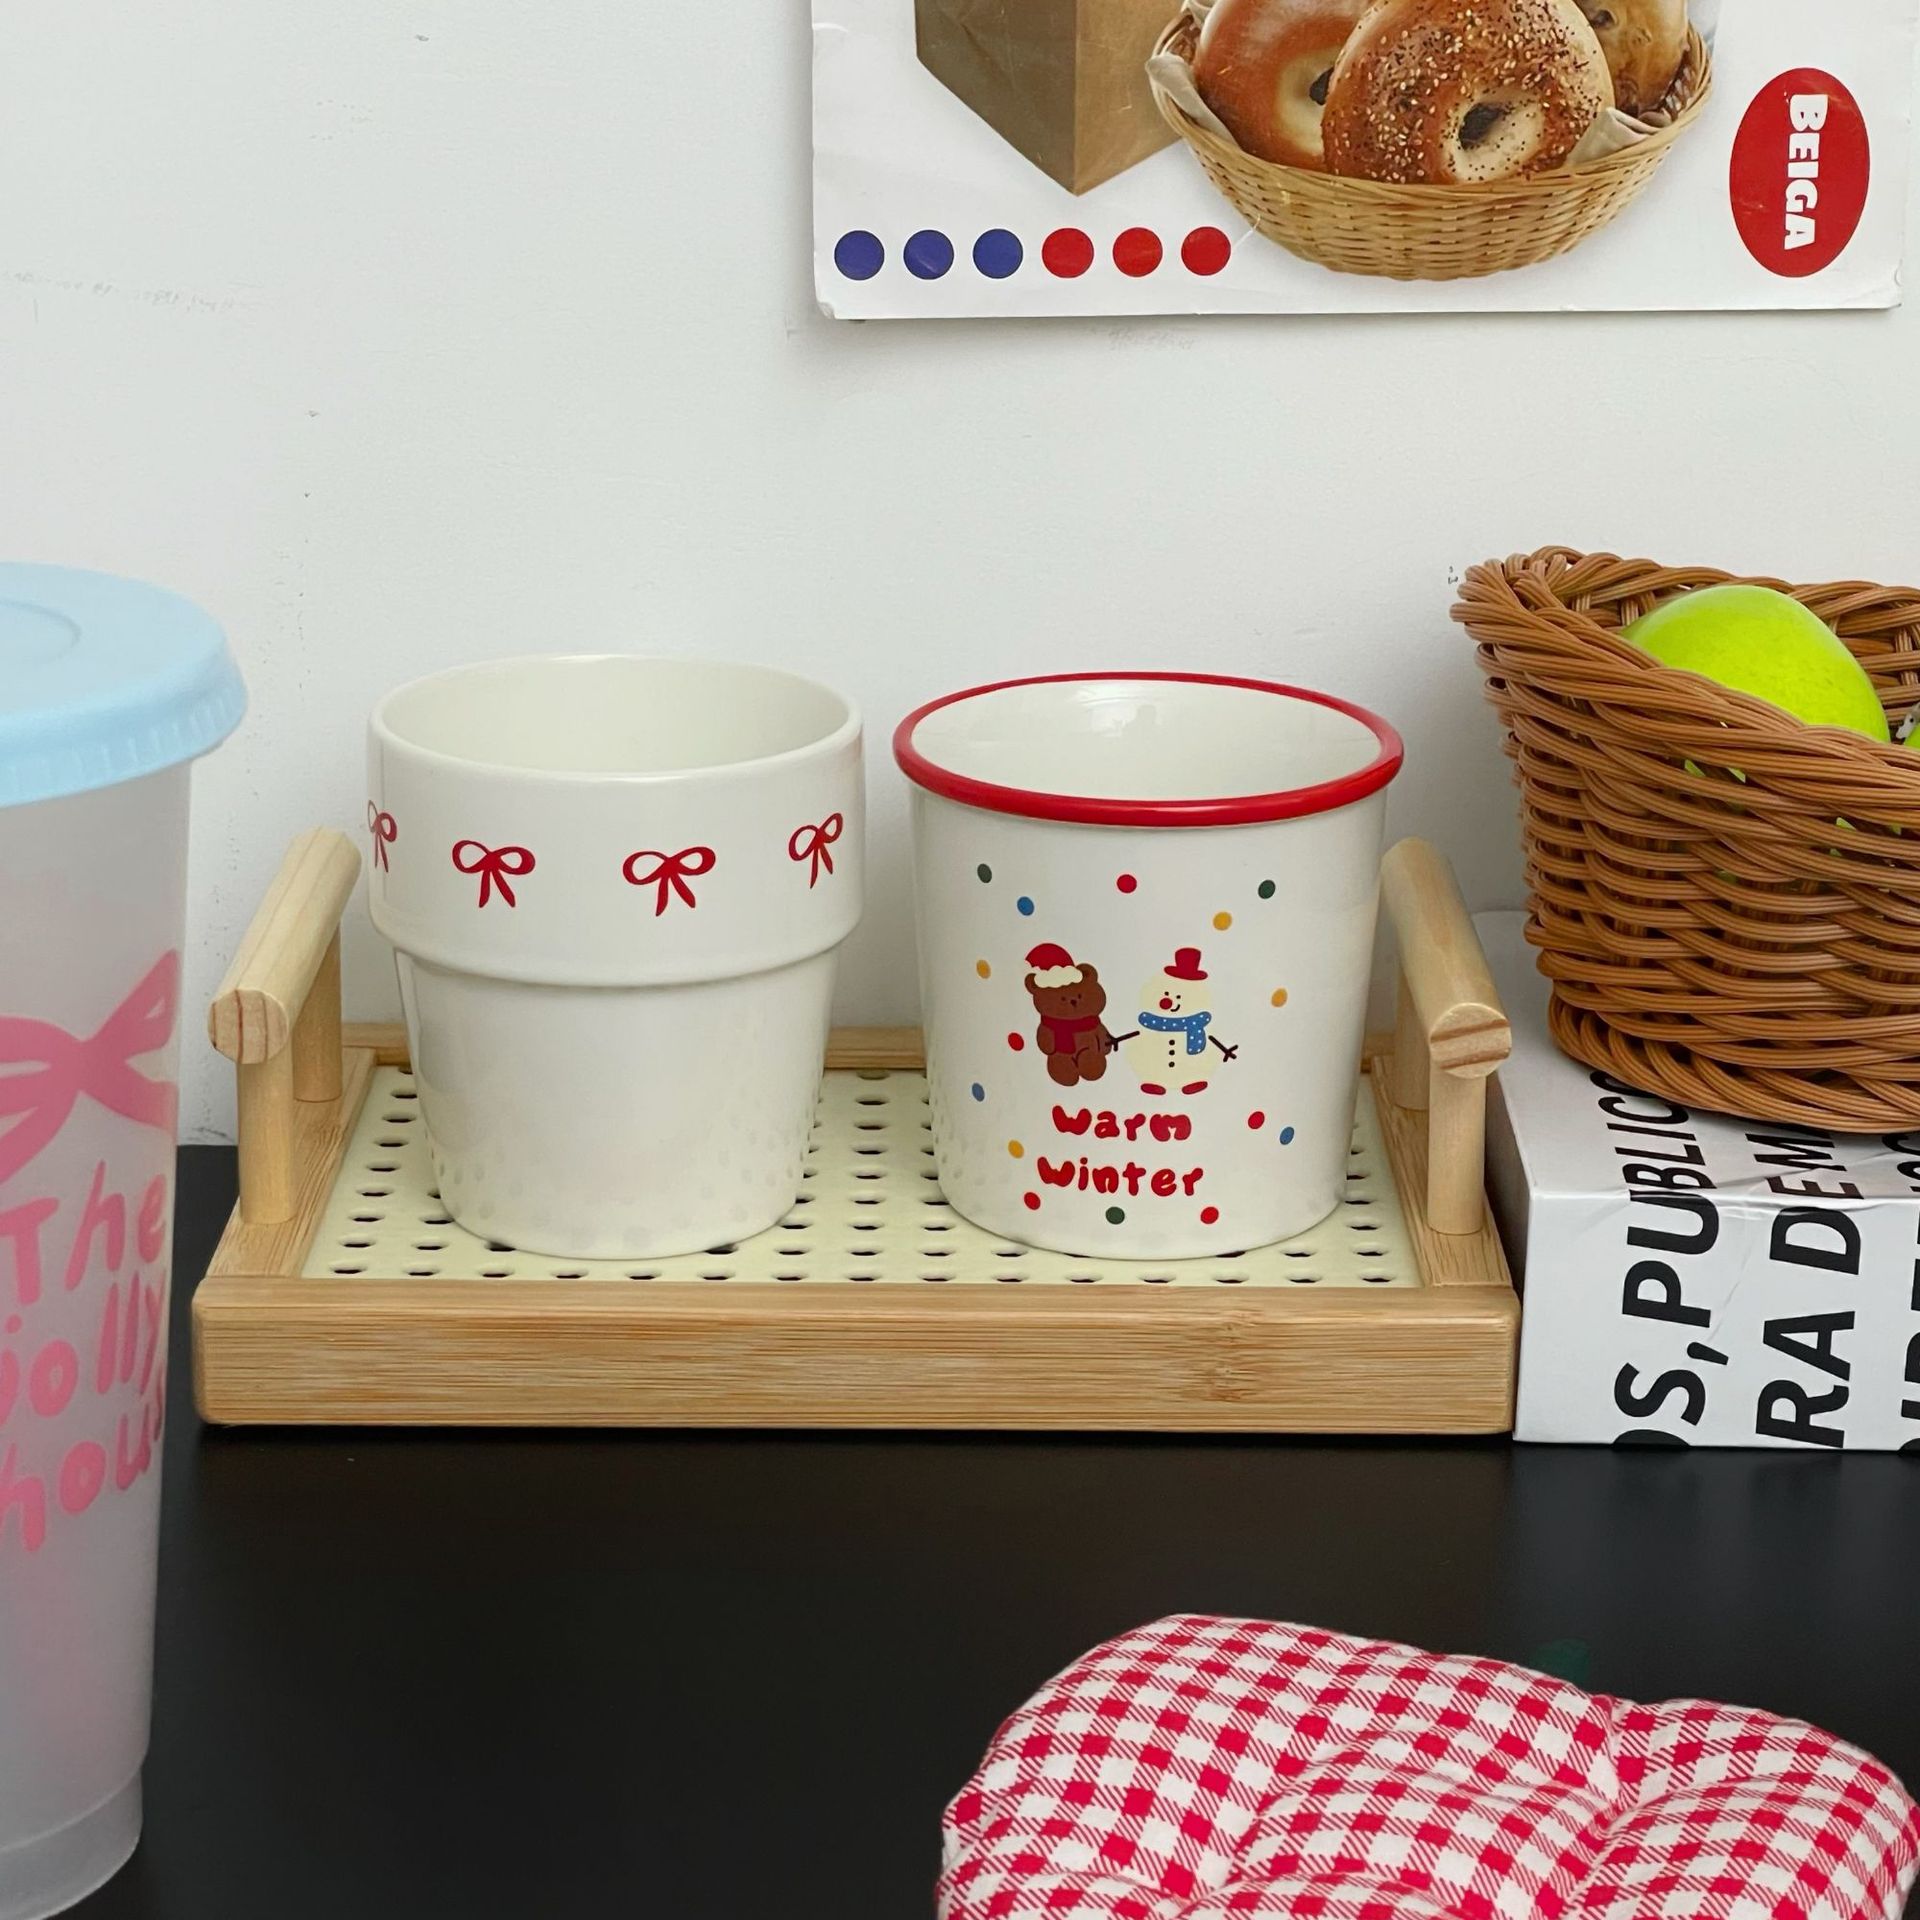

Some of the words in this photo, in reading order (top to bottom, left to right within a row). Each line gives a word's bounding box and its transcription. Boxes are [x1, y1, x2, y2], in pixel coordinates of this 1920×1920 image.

[1784, 94, 1828, 250] BEIGA
[0, 1159, 167, 1305] The
[1755, 1311, 1855, 1448] RA
